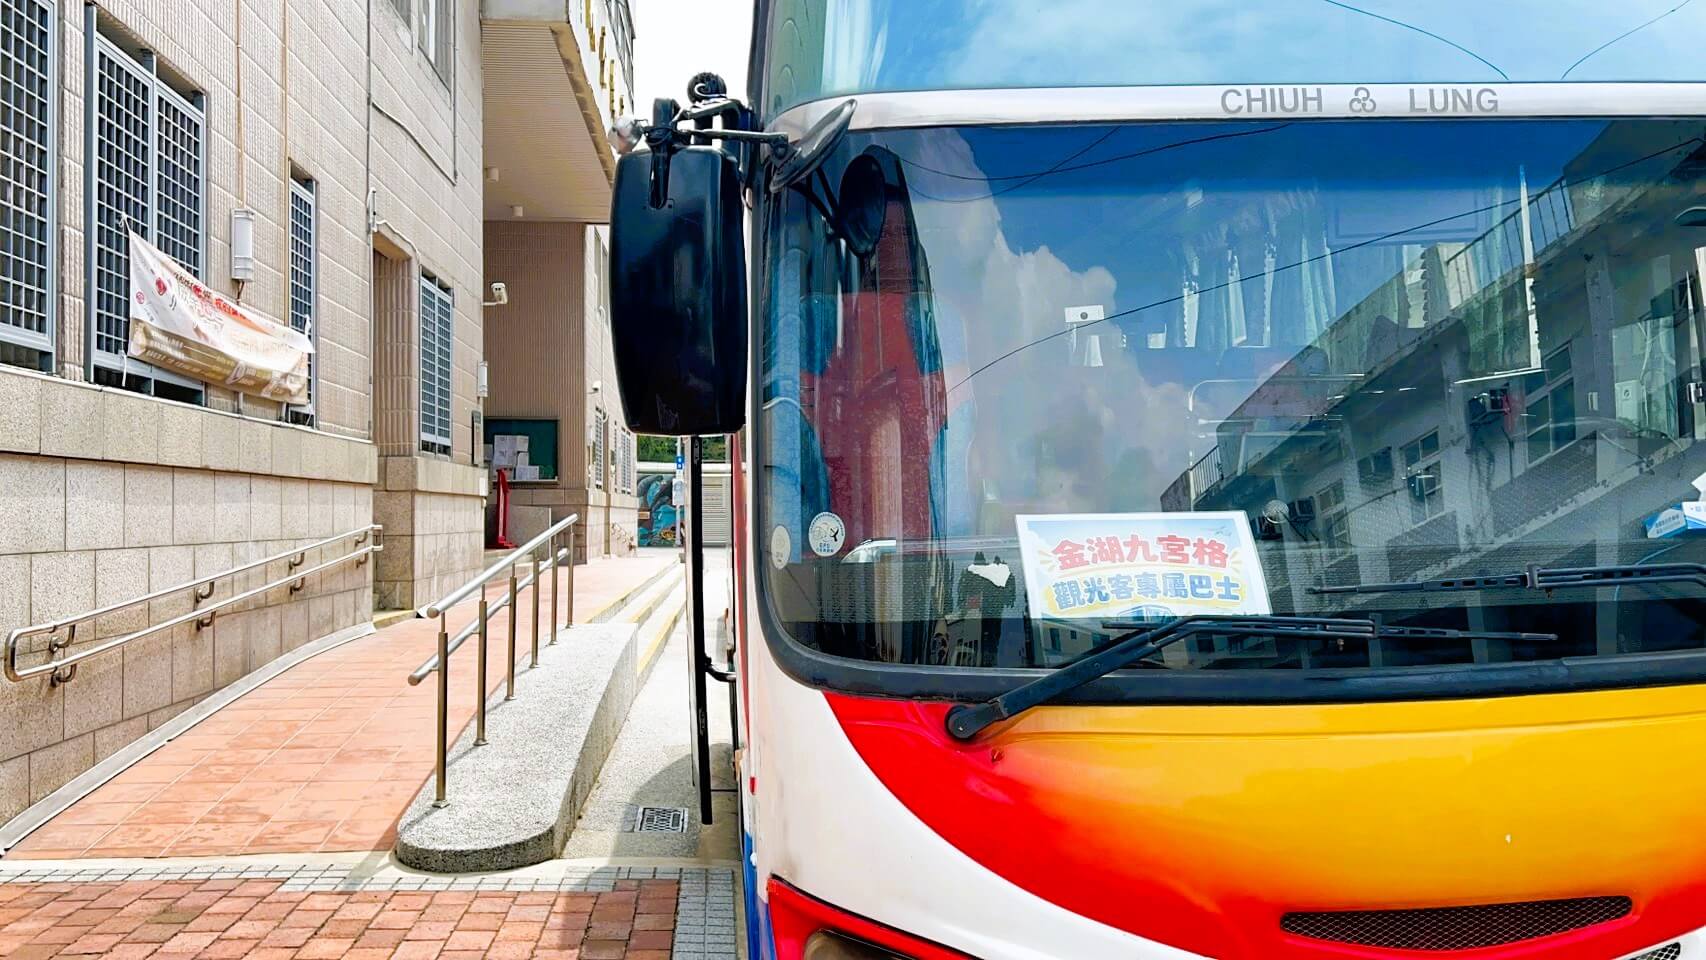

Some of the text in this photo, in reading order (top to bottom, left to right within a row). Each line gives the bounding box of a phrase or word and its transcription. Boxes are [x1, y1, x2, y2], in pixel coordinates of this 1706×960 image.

[1220, 88, 1499, 113] CHIUH LUNG
[1052, 534, 1229, 571] 金湖九宮格
